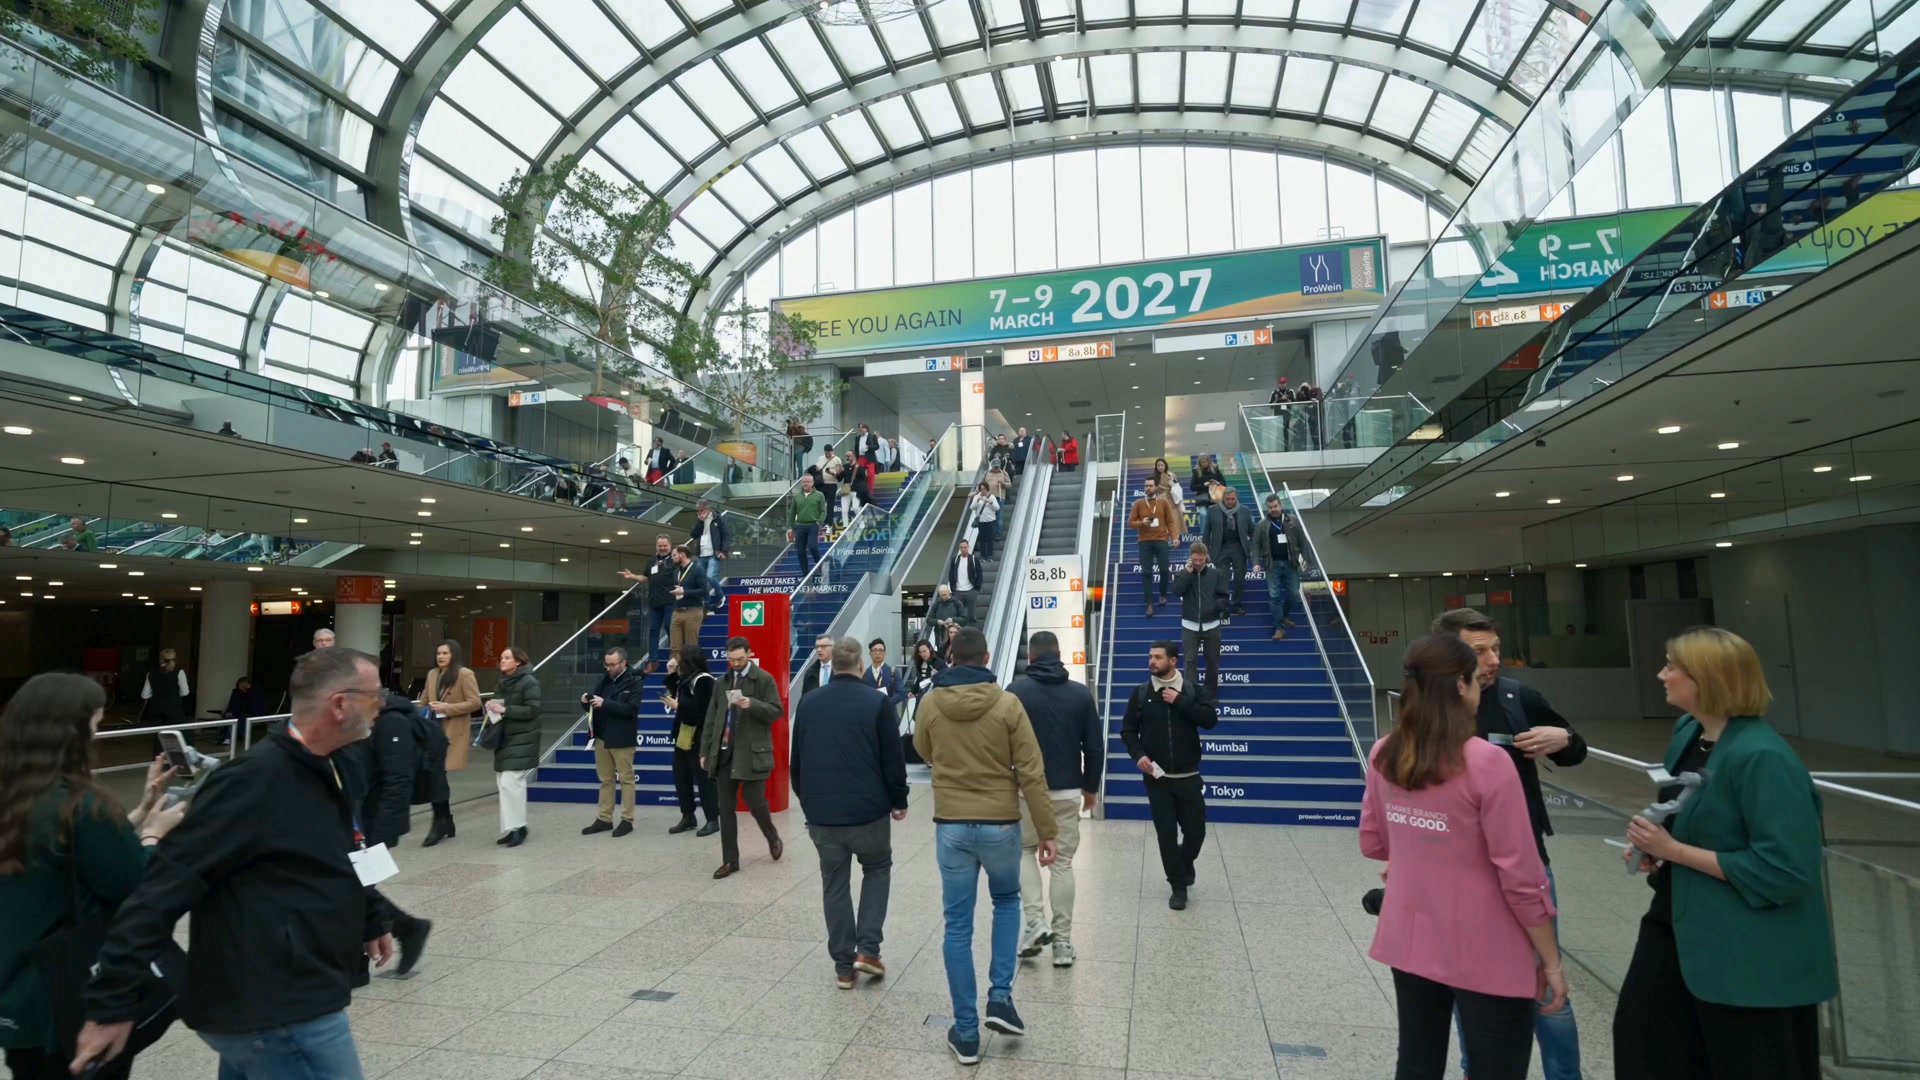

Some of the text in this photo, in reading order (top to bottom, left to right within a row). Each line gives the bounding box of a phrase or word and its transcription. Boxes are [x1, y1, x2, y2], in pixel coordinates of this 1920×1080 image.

[1303, 283, 1342, 294] ProWein
[1070, 267, 1212, 323] 2027
[847, 315, 888, 335] YOU
[894, 308, 962, 331] AGAIN
[989, 312, 1053, 331] MARCH
[1030, 567, 1066, 582] 8a,8b
[740, 578, 772, 586] PROWEIN
[774, 577, 796, 585] TAKES
[748, 586, 762, 594] THE
[1198, 672, 1250, 683] Hg Kong
[1223, 706, 1252, 716] Paulo
[1205, 742, 1249, 752] Mumbai
[1211, 786, 1245, 798] Tokyo
[1298, 814, 1356, 822] prowein-world.com
[1413, 809, 1449, 821] BRANDS
[1409, 816, 1451, 832] GOOD.
